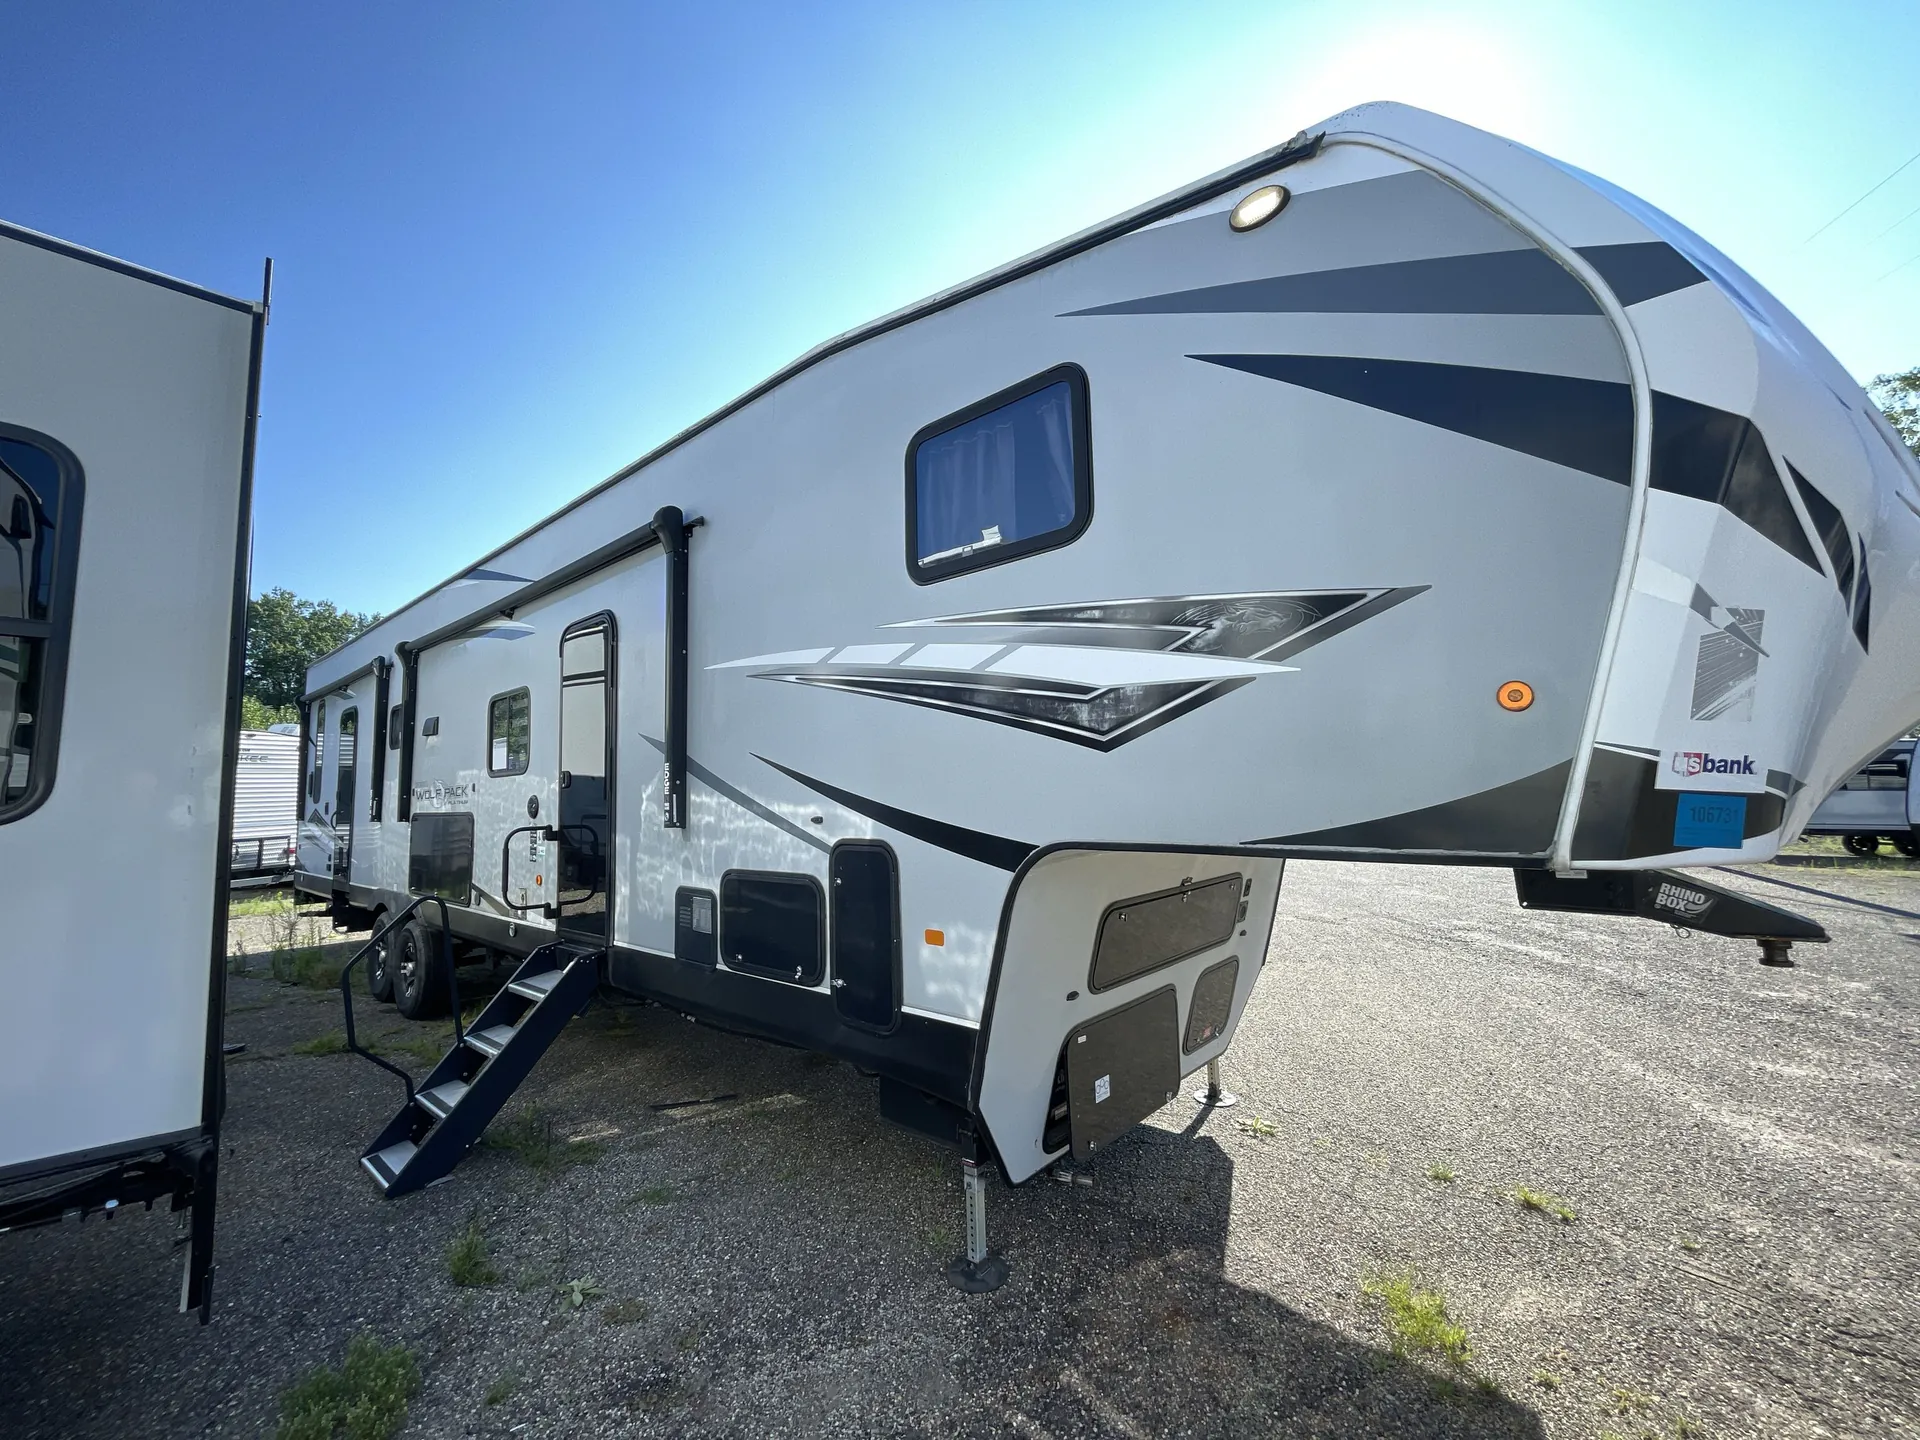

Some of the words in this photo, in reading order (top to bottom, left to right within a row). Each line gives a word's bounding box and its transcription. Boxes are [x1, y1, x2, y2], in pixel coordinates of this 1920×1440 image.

[415, 789, 441, 800] WOLF
[444, 786, 468, 798] PACK
[1655, 893, 1688, 911] BOX
[1659, 882, 1705, 904] RHINO
